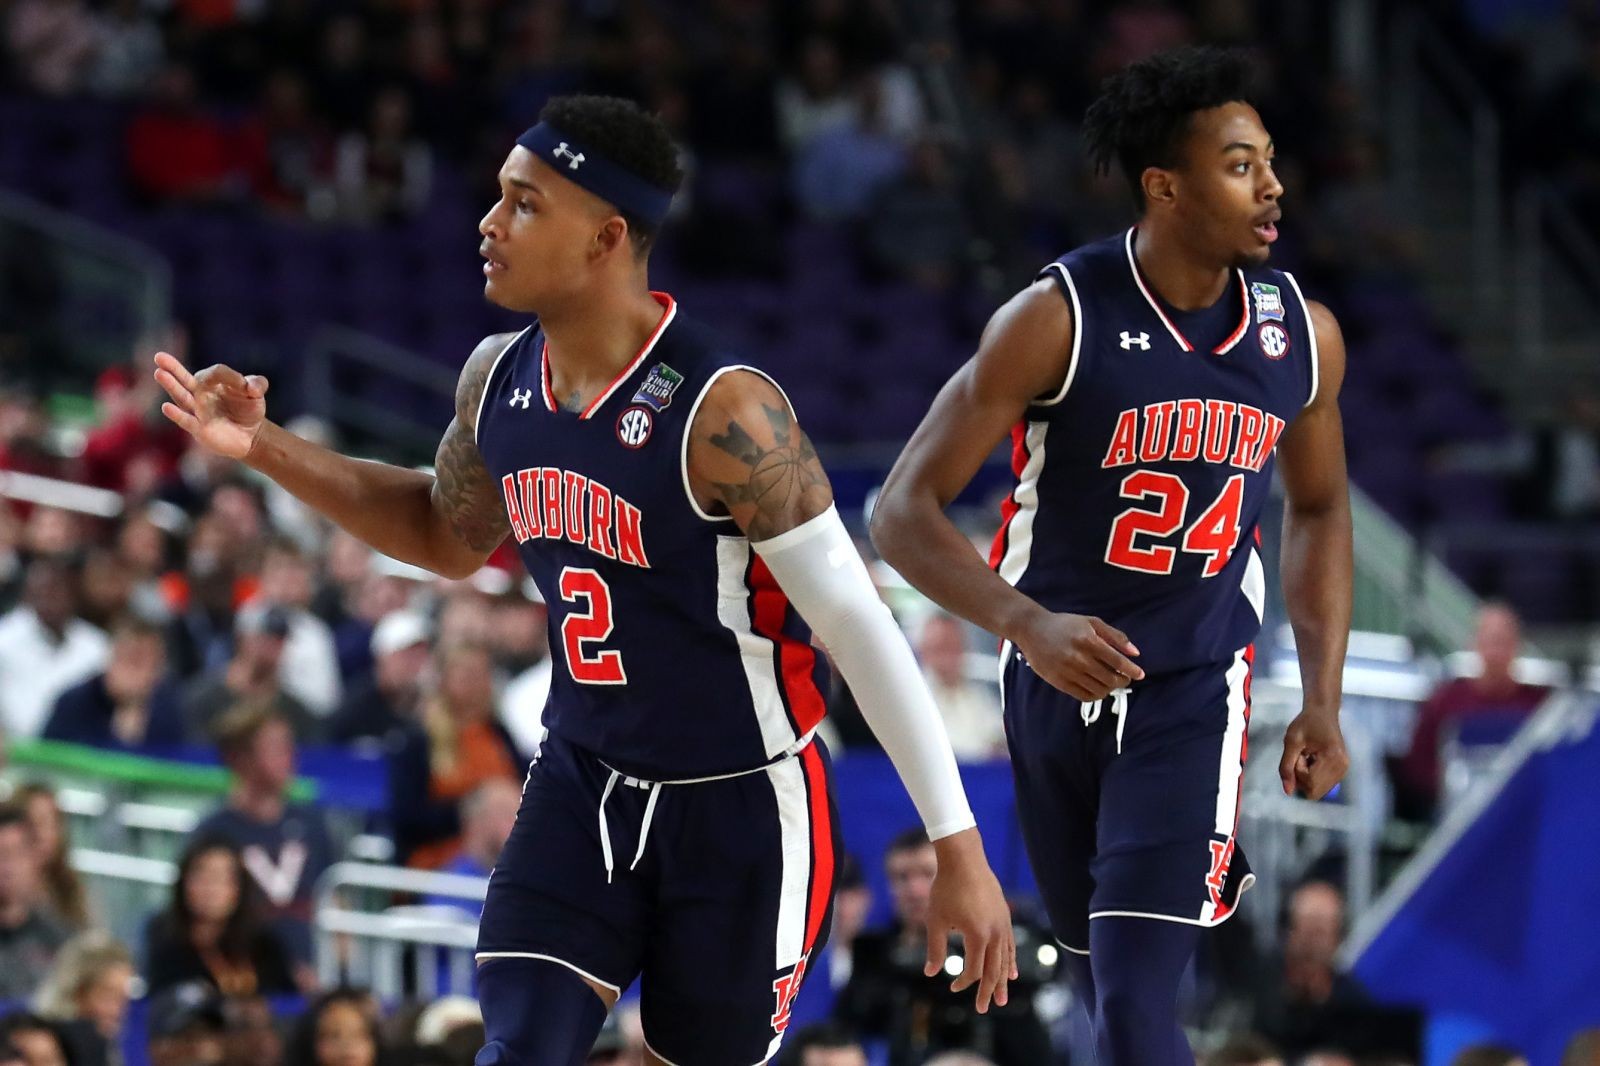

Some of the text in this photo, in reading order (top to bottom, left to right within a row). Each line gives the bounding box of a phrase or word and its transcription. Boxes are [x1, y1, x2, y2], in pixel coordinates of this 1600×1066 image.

[1260, 325, 1287, 357] SEC
[641, 382, 670, 399] FOUR
[647, 374, 674, 391] FINAL
[620, 409, 649, 445] SEC
[1101, 398, 1286, 473] AUBURN
[501, 466, 651, 568] AUBURN
[1104, 469, 1245, 578] 24
[559, 565, 627, 685] 2
[242, 841, 307, 906] V
